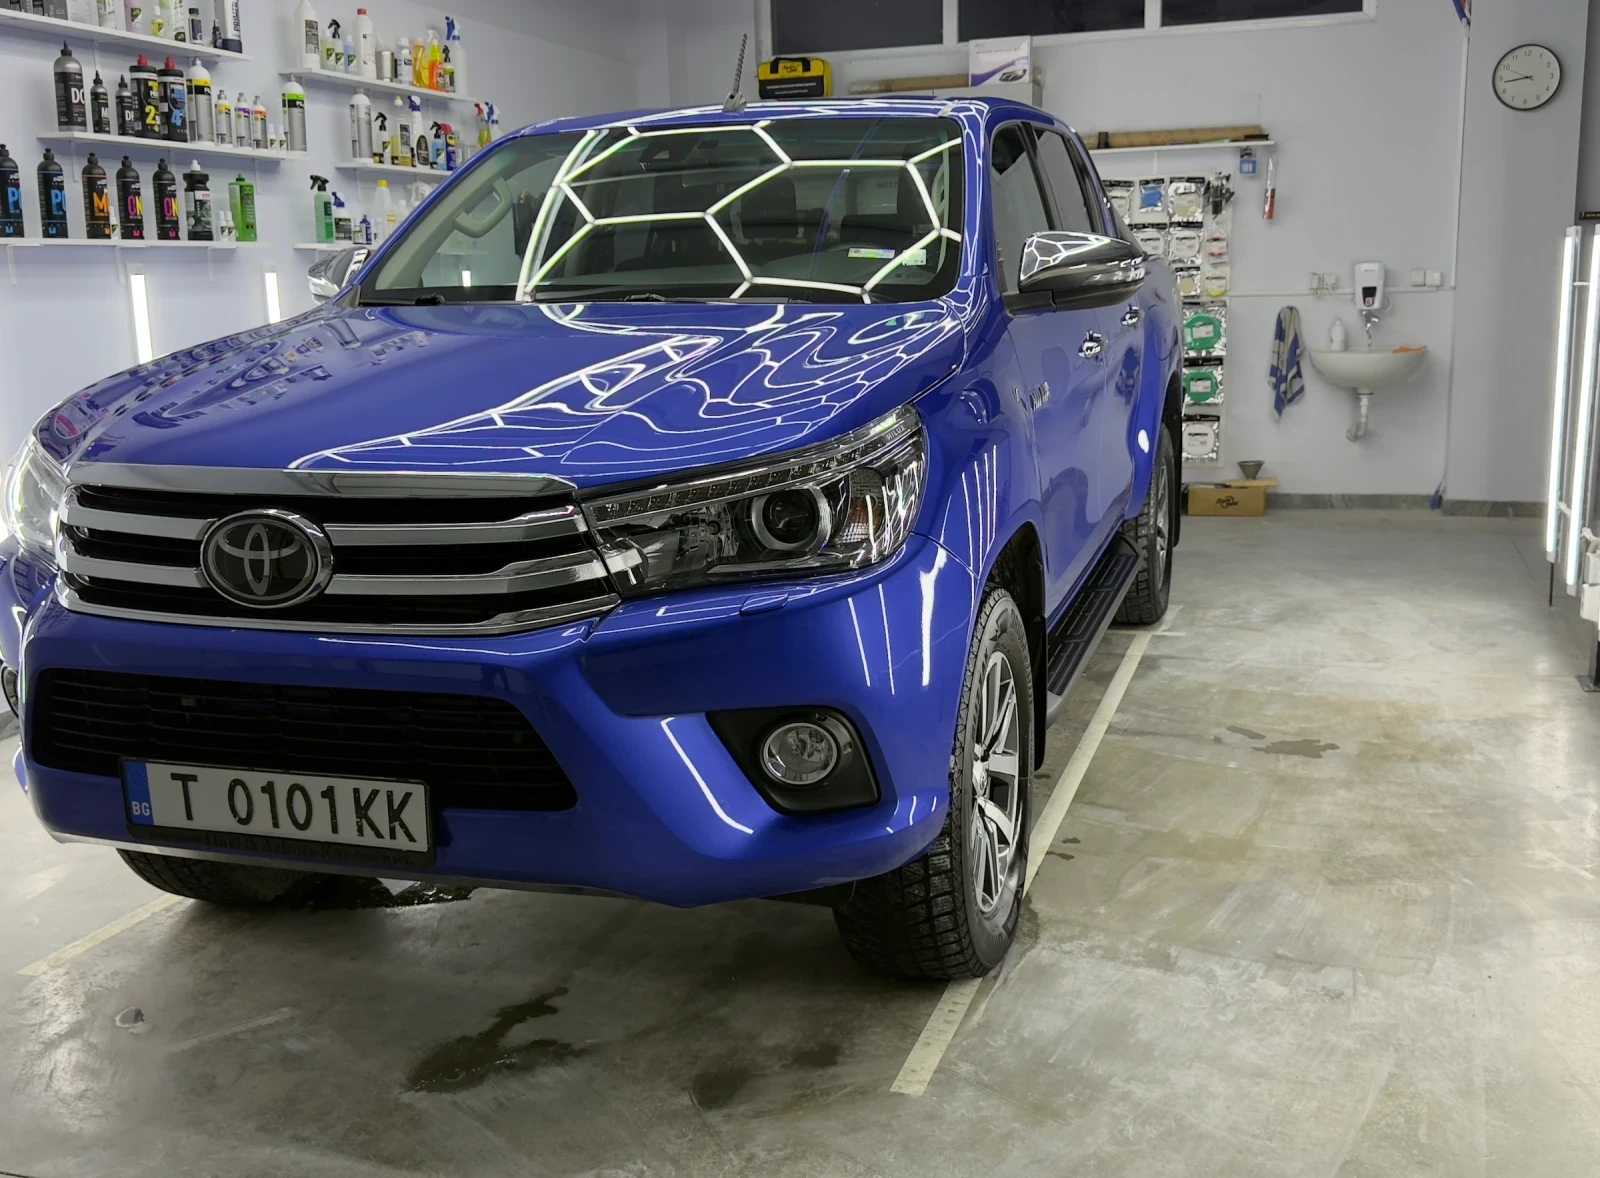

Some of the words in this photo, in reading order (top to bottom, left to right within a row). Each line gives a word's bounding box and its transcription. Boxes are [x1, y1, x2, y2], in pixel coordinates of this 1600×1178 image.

[885, 424, 906, 441] HILUX
[169, 772, 199, 821] T
[132, 801, 150, 816] BG
